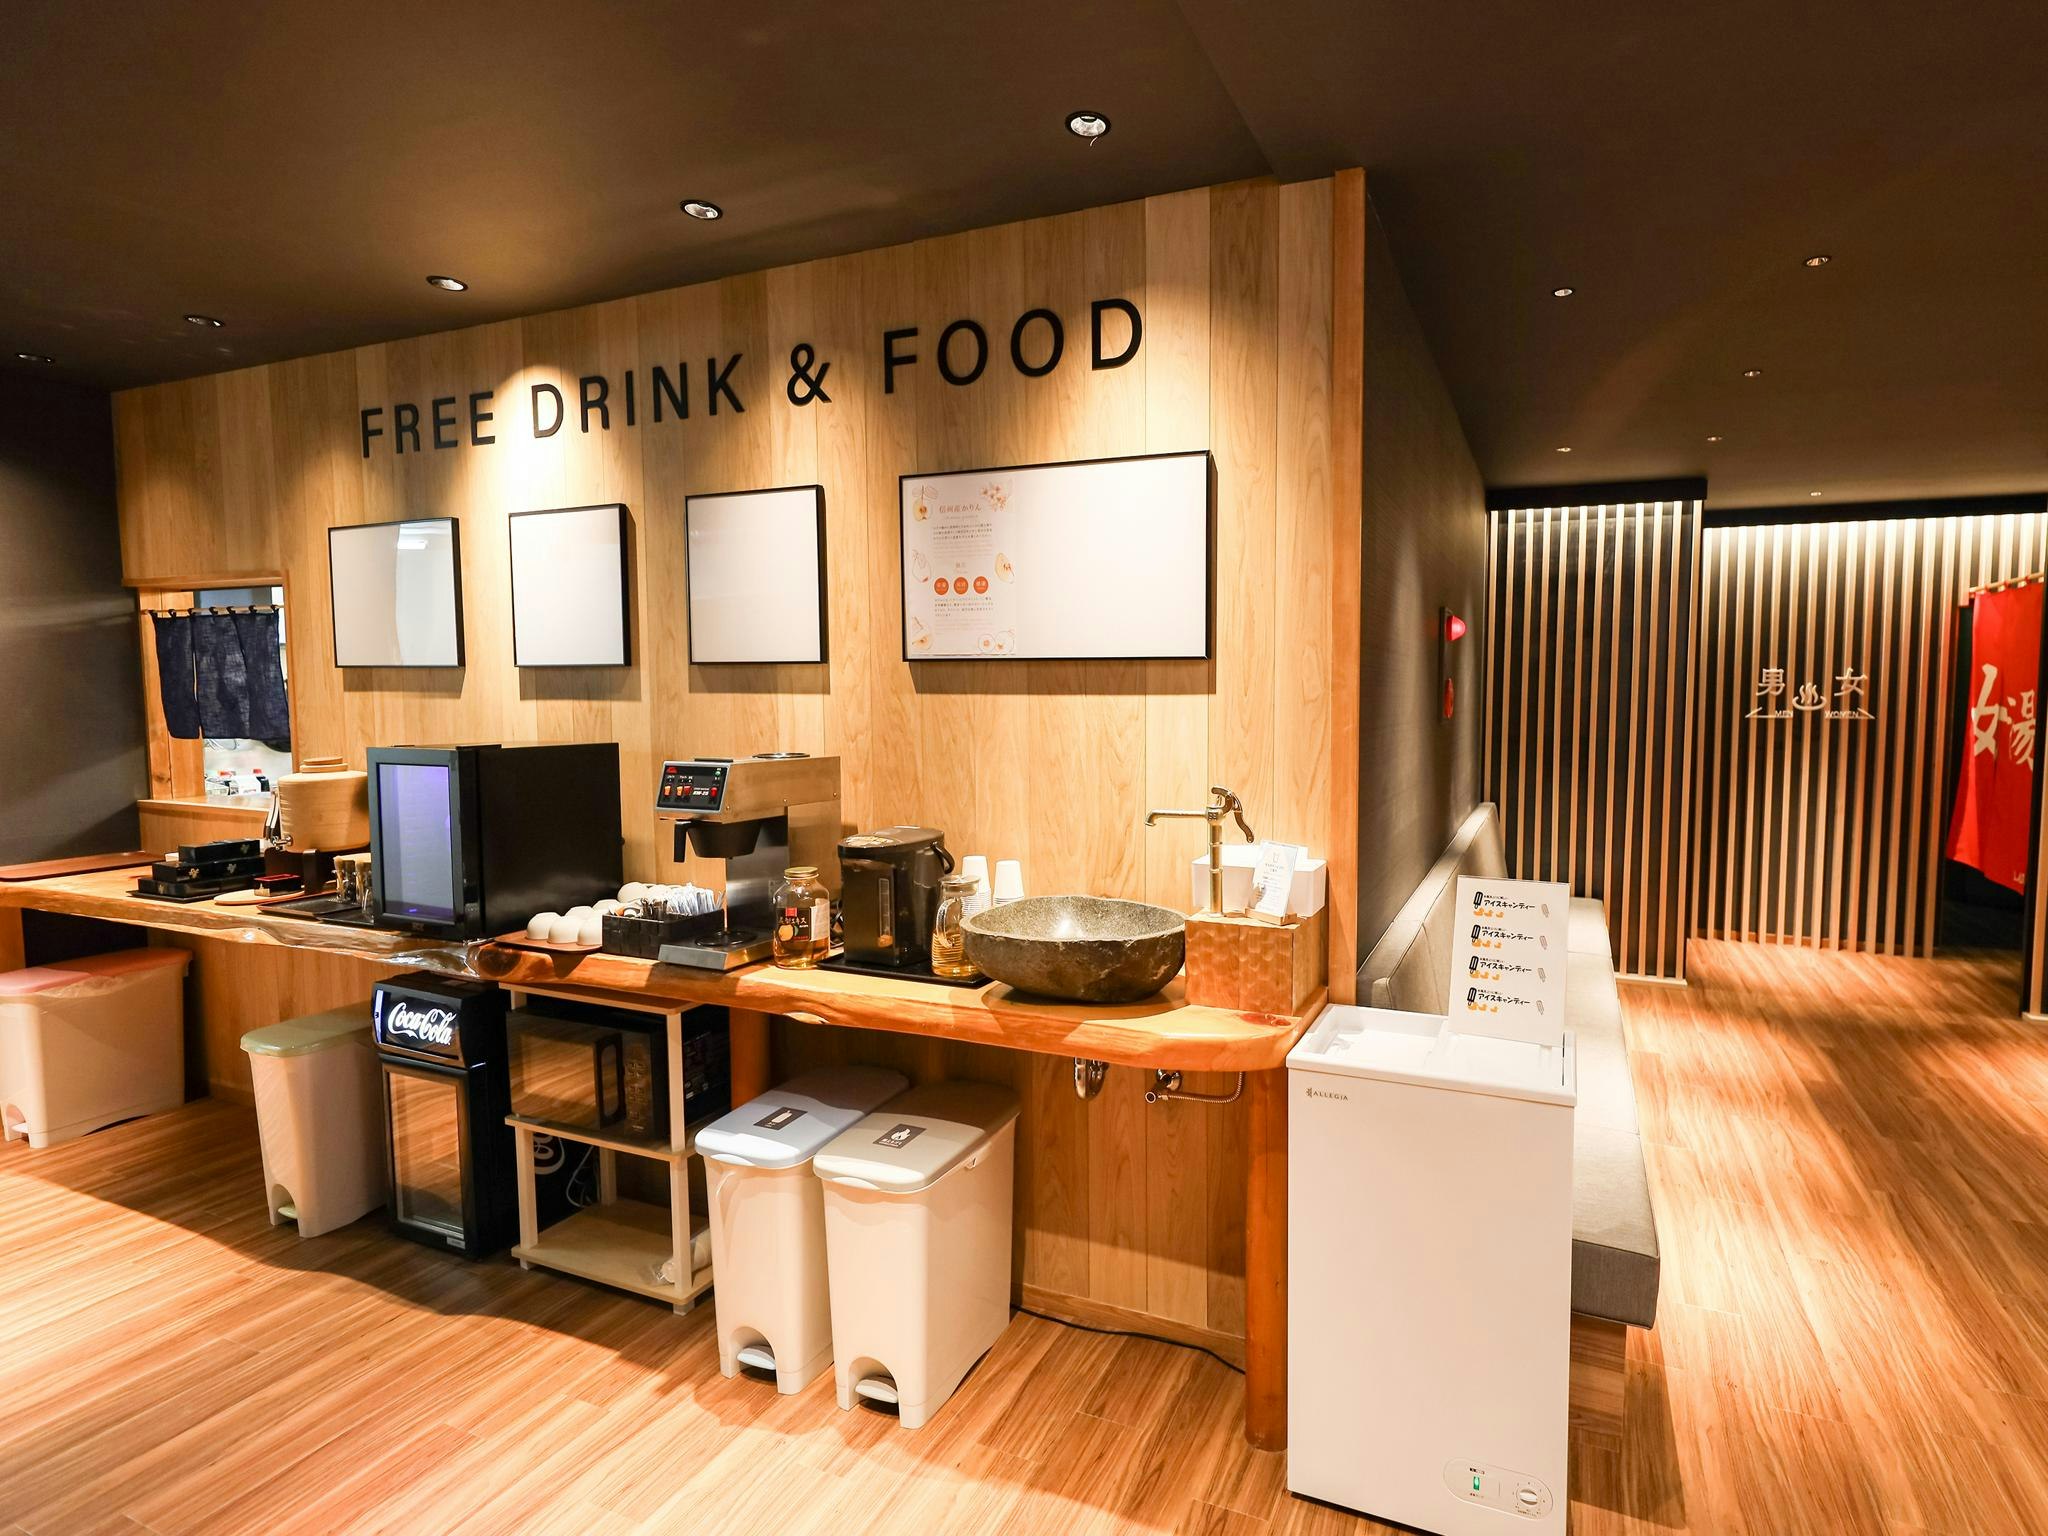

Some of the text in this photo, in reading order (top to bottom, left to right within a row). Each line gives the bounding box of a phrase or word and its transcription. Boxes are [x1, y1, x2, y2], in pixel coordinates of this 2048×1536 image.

[361, 297, 1143, 458] FREE DRINK & FOOD
[1756, 667, 1786, 697] 男
[1833, 666, 1868, 697] 女
[1775, 709, 1794, 718] MEN
[1824, 709, 1860, 719] WOMEN
[1483, 899, 1536, 910] アイスキャンディー
[1481, 930, 1535, 941] アイスキャンディー
[1479, 961, 1532, 973] アイスキャンディー
[1477, 993, 1530, 1005] アイスキャンディー
[388, 1002, 457, 1045] Coca-Cola
[1313, 1091, 1348, 1101] ALLEGIA
